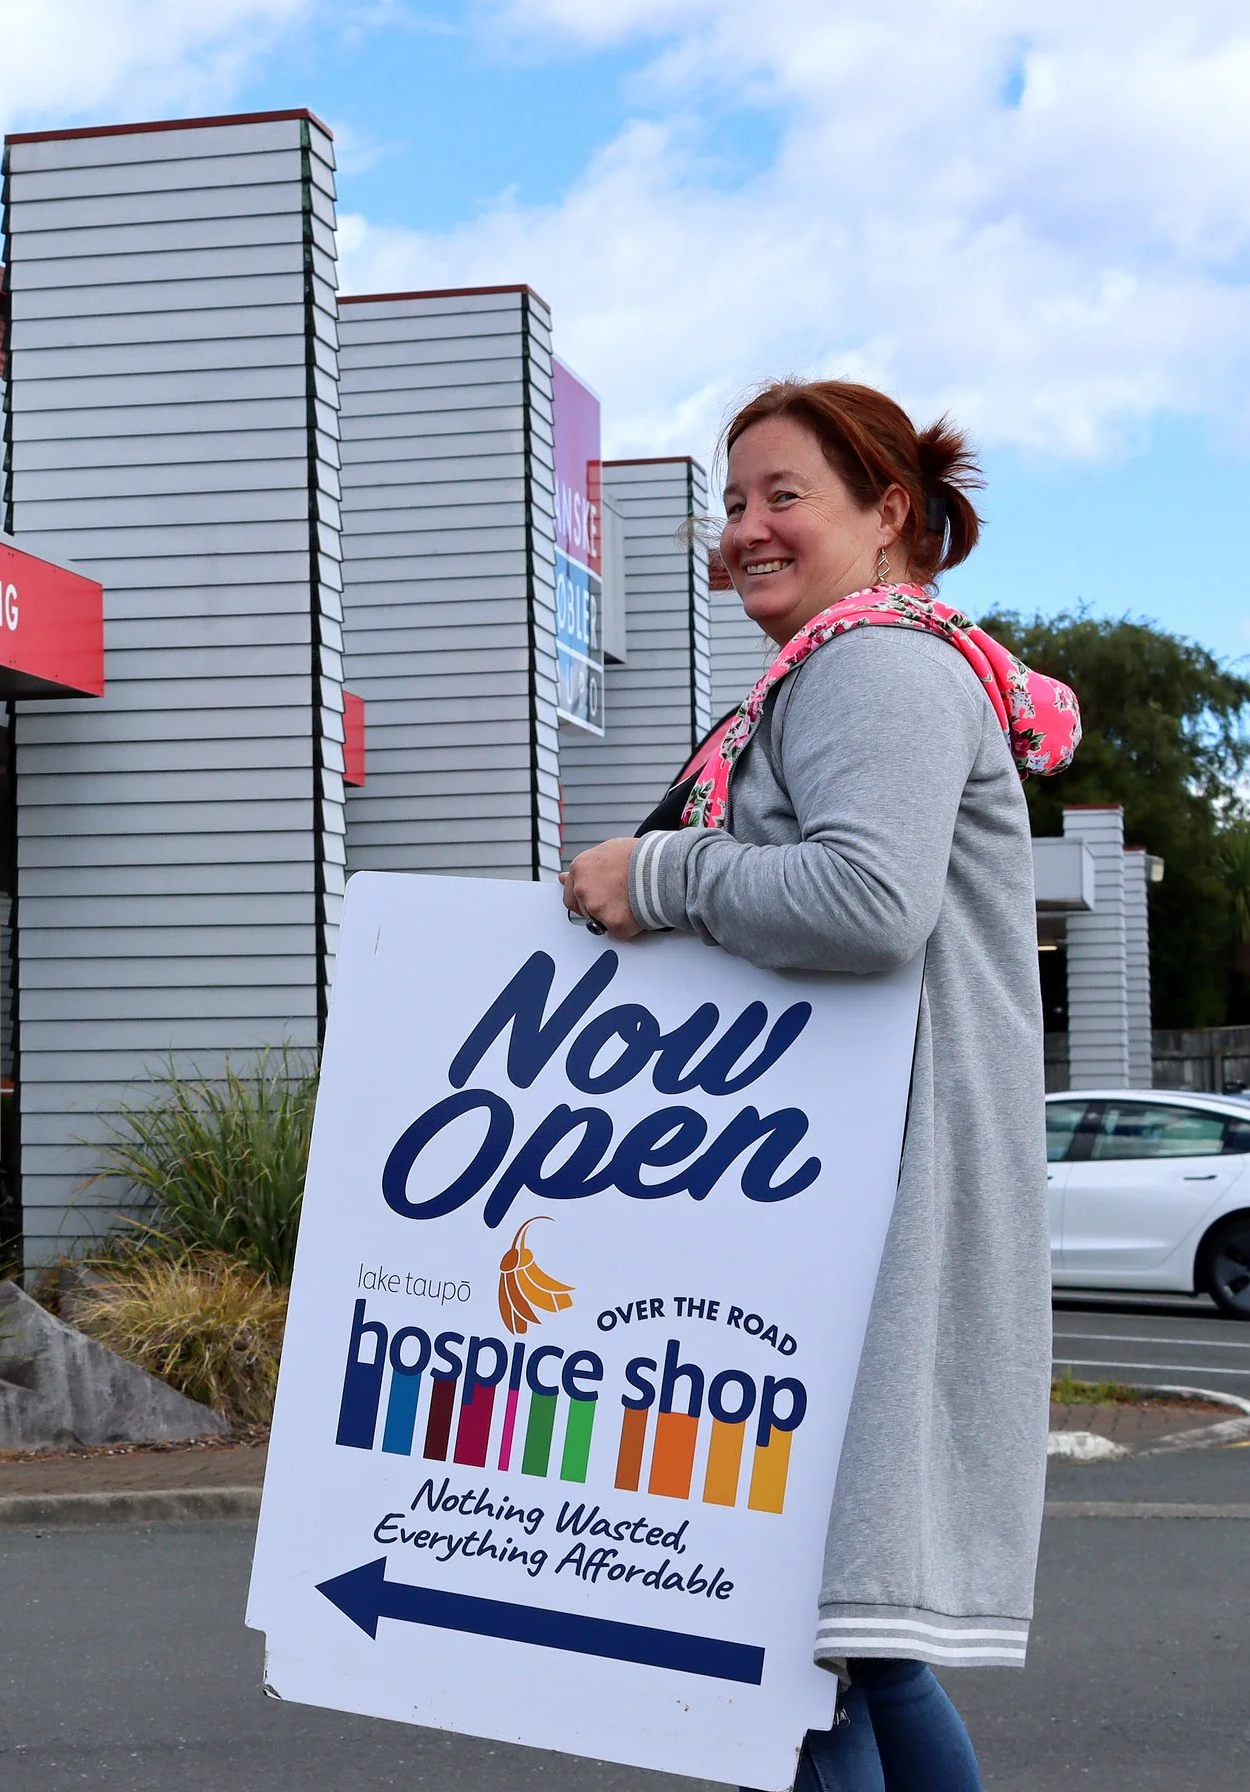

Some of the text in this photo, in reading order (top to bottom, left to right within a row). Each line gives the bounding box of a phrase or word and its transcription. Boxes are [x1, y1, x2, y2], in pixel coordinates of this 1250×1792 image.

[554, 476, 598, 558] ANSKE
[556, 573, 598, 649] ØBLER
[449, 949, 812, 1096] Now
[382, 1088, 821, 1228] Open
[358, 1263, 471, 1306] lake taupō
[597, 1297, 798, 1356] OVER THE ROAD
[349, 1298, 807, 1447] hospice shop
[373, 1513, 734, 1600] Everything Affordable
[410, 1478, 690, 1554] Nothing Wasted,
